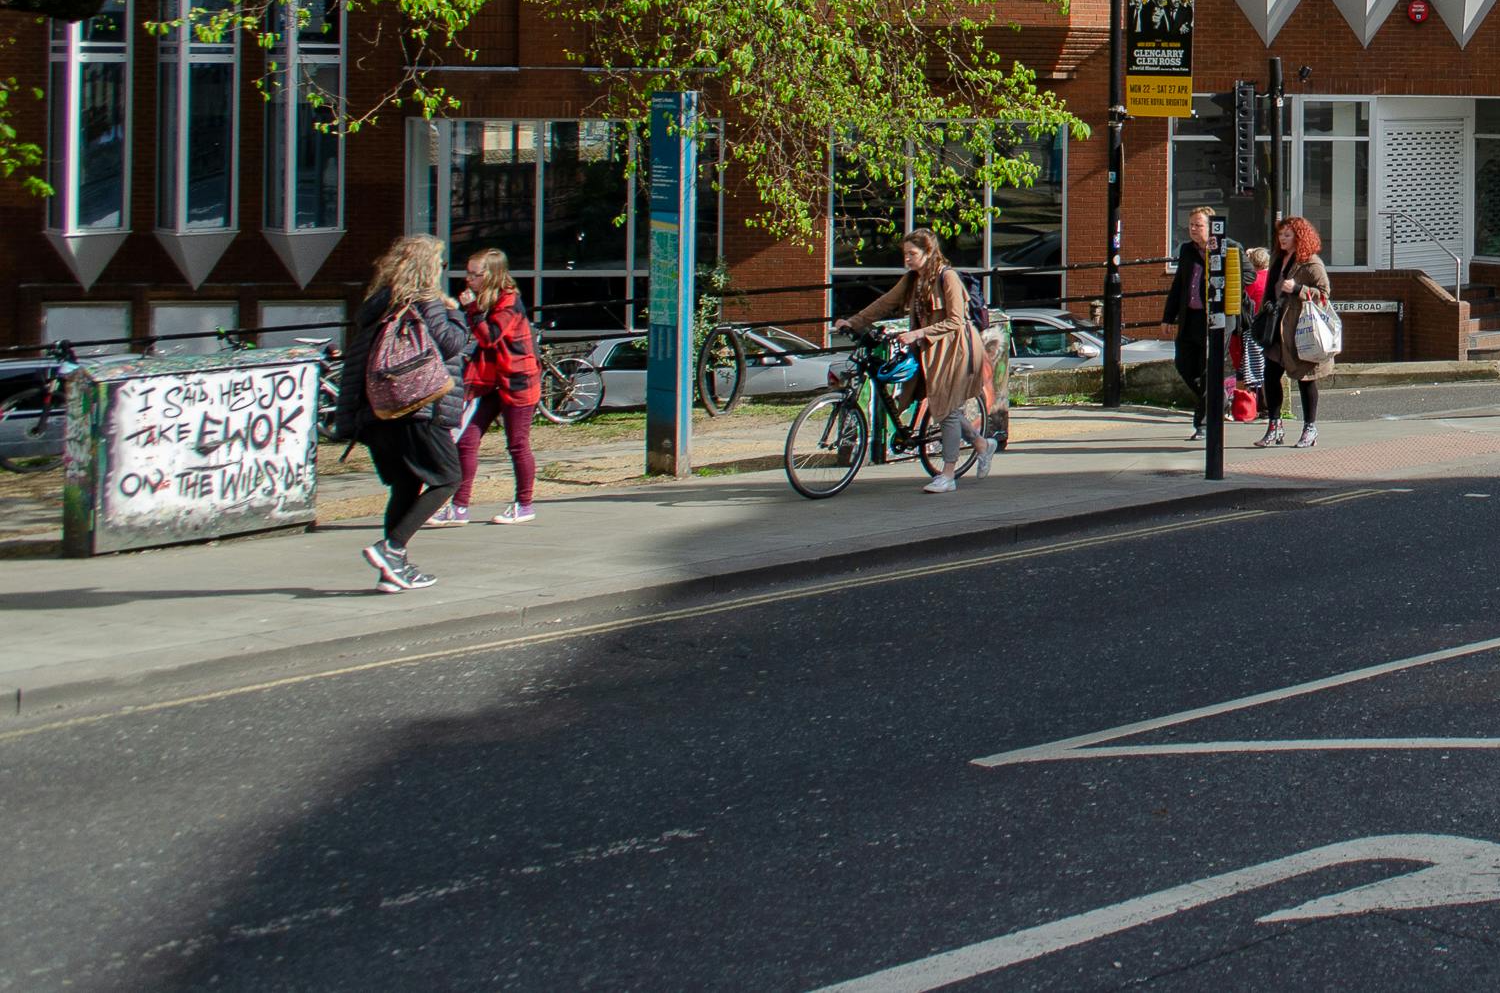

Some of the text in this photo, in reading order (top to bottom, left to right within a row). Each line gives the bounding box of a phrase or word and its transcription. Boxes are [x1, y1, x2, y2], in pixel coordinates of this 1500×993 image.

[1159, 58, 1181, 66] ROSS
[1143, 84, 1150, 94] 22
[1157, 84, 1167, 94] SAT
[1168, 85, 1176, 94] 27
[1177, 85, 1188, 94] APR
[1130, 97, 1188, 107] THEATRE ROYAL BRIGHTON
[1358, 303, 1382, 311] ROAD
[125, 405, 304, 455] TAKE EWOK
[120, 469, 165, 497] ON
[175, 471, 214, 499] THE
